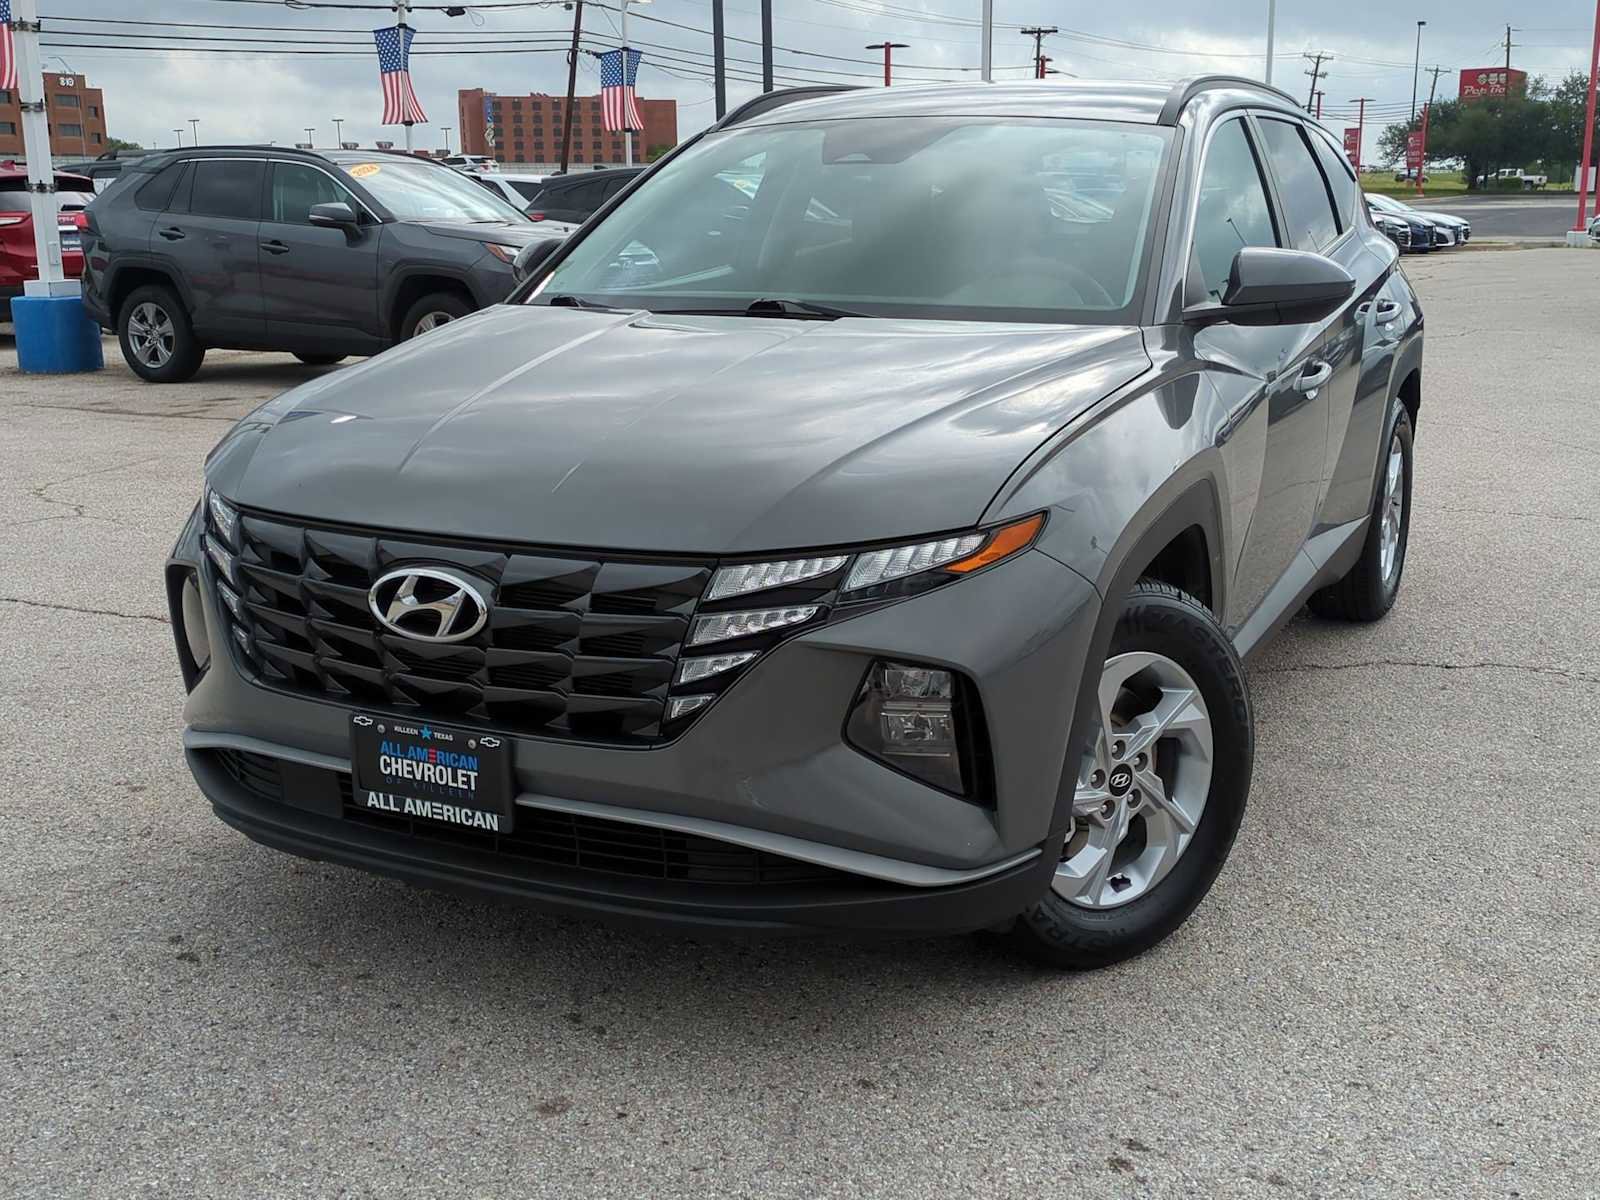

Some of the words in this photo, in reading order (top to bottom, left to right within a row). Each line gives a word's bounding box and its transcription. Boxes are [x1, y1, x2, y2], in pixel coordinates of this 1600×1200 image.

[394, 726, 419, 736] KILLEEN
[434, 732, 453, 741] TEXAS
[380, 741, 404, 757] ALL
[408, 746, 478, 770] AMERICAN
[380, 755, 478, 790] CHEVROLET
[367, 792, 400, 812] ALL
[404, 798, 499, 831] AMERICAN
